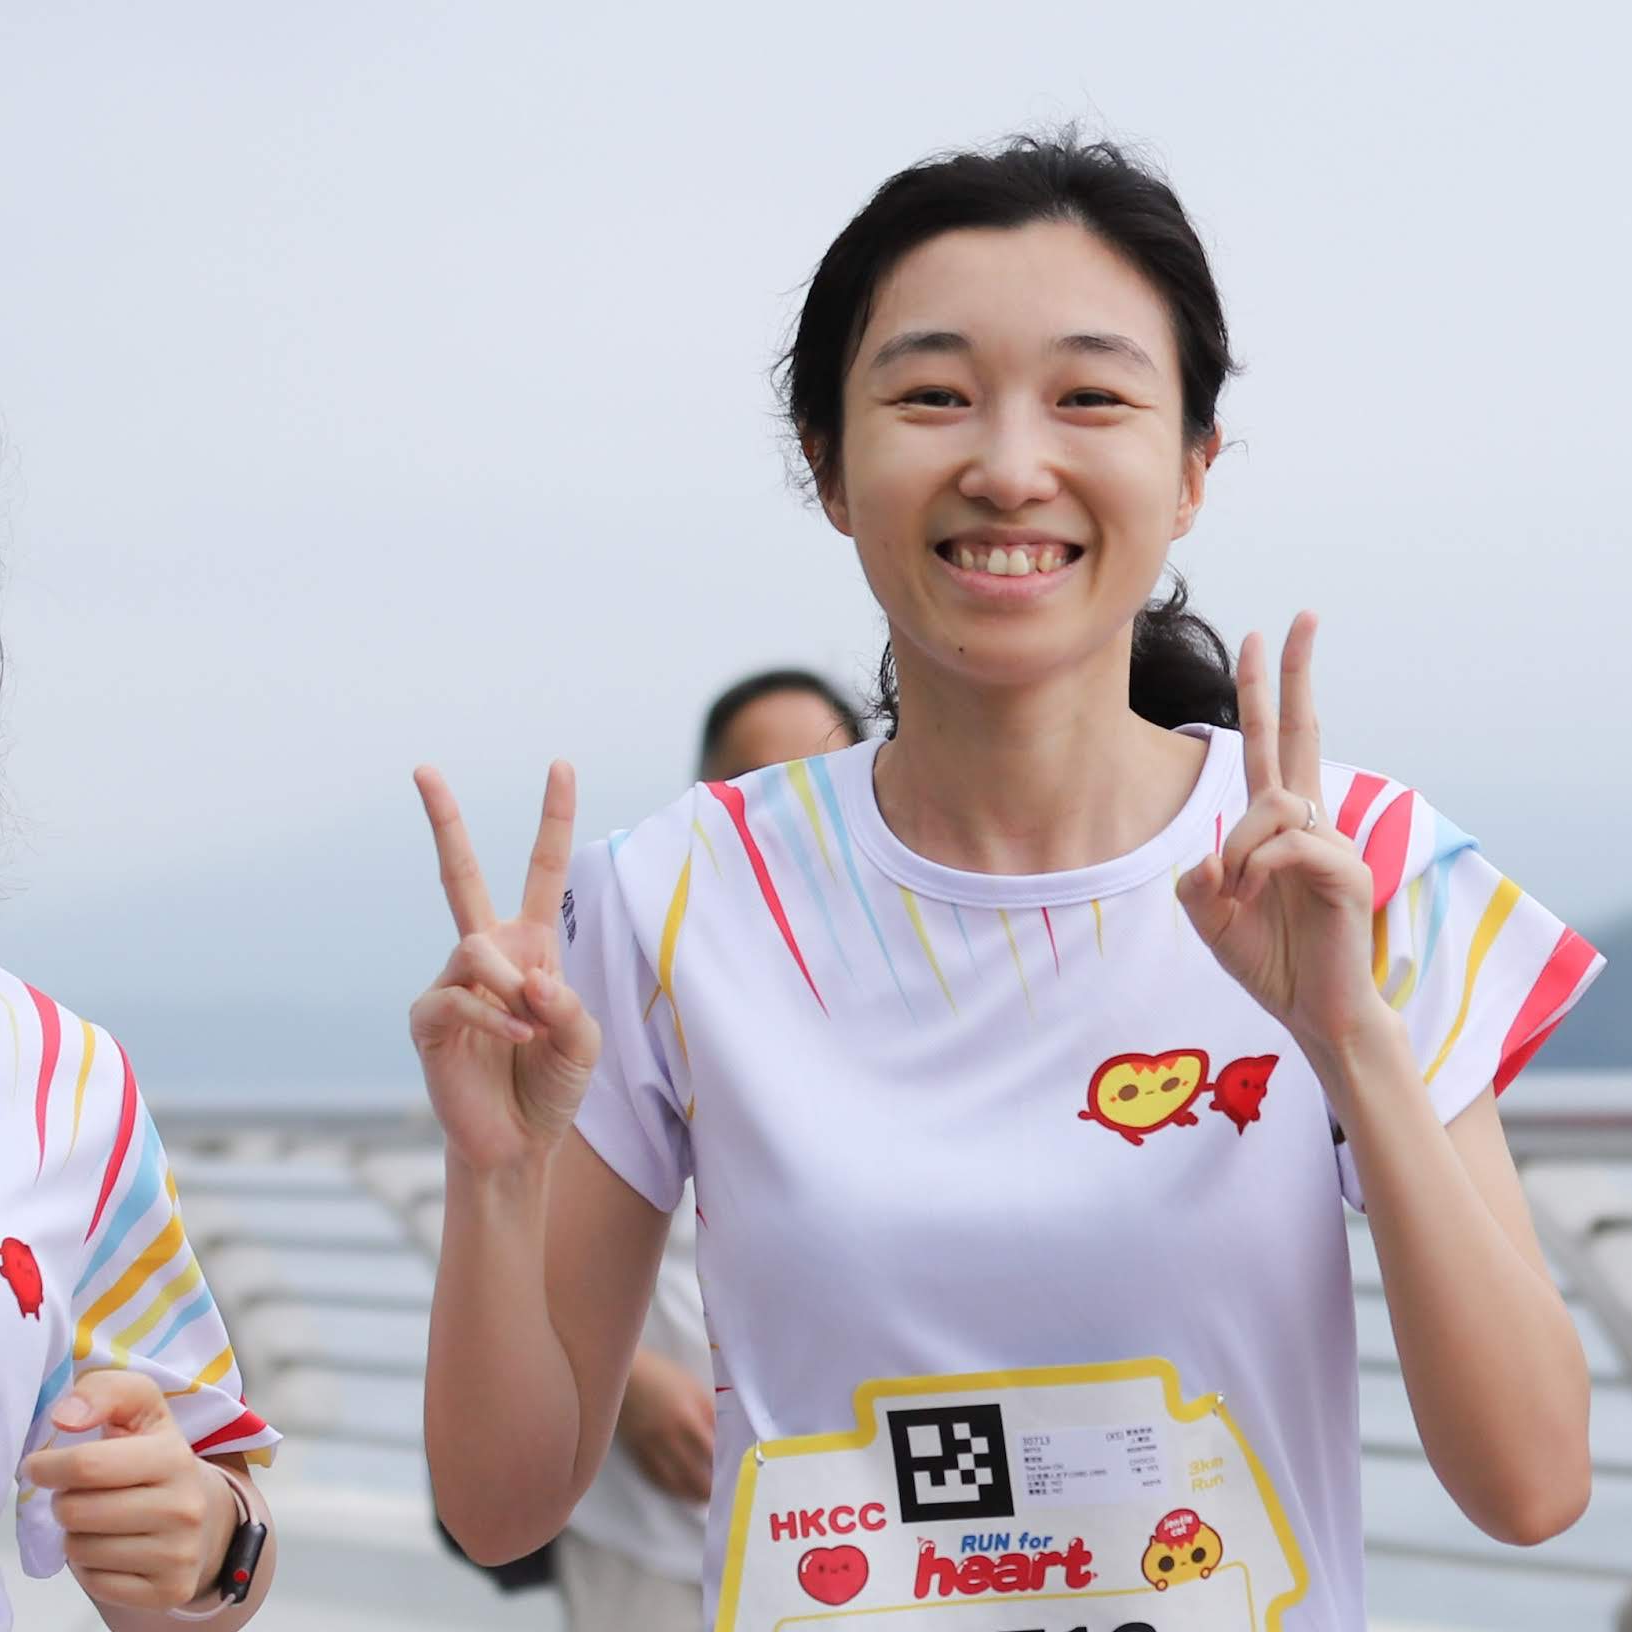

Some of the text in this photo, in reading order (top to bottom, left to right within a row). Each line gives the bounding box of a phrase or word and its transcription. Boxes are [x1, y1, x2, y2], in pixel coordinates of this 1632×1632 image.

[1192, 1474, 1224, 1494] Run
[769, 1502, 887, 1542] HKCC
[960, 1531, 1053, 1554] RUN for
[913, 1537, 1093, 1599] heart
